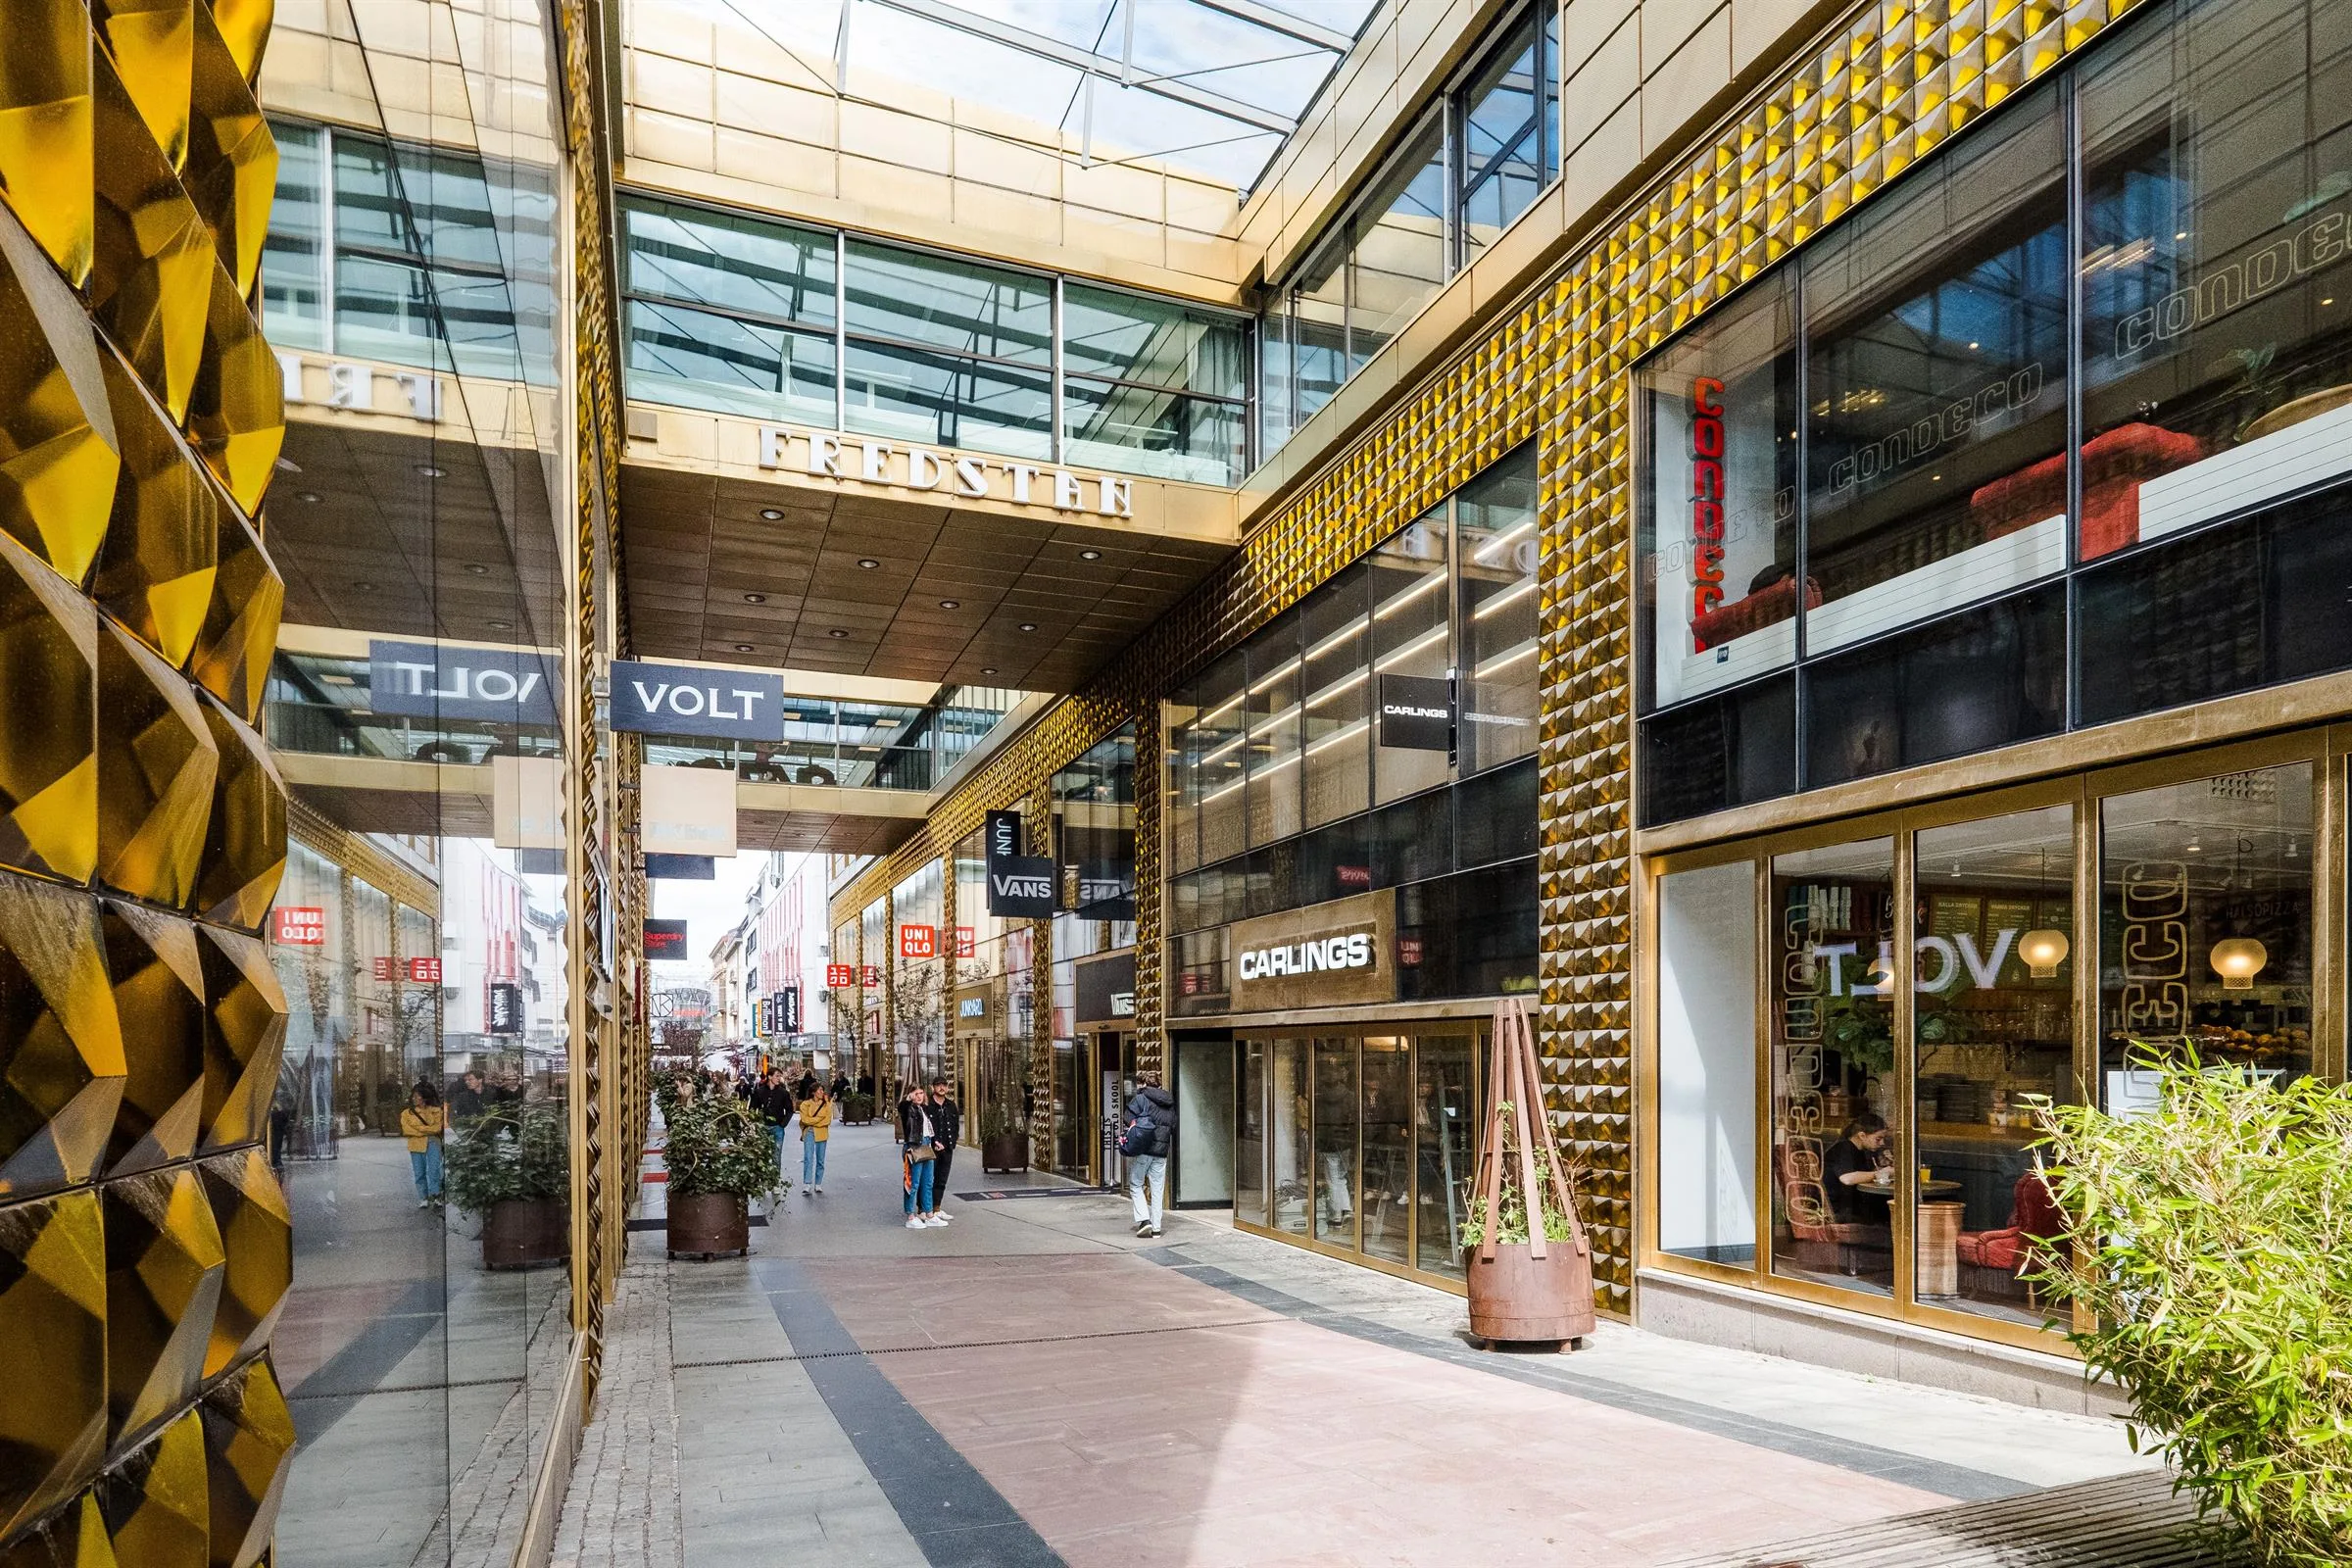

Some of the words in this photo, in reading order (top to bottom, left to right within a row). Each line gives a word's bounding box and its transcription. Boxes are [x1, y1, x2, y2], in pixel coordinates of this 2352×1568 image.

[2114, 211, 2352, 361] CONDE
[759, 425, 1134, 518] FREDSTAN
[1692, 376, 1725, 654] CONDEC
[631, 681, 765, 721] VOLT
[1384, 705, 1448, 719] CARLINGS
[996, 817, 1012, 856] JUN
[993, 874, 1052, 899] VANS
[645, 931, 684, 941] Superdry
[905, 928, 928, 941] UNI
[905, 942, 931, 955] QLO
[1239, 933, 1370, 981] CARLINGS
